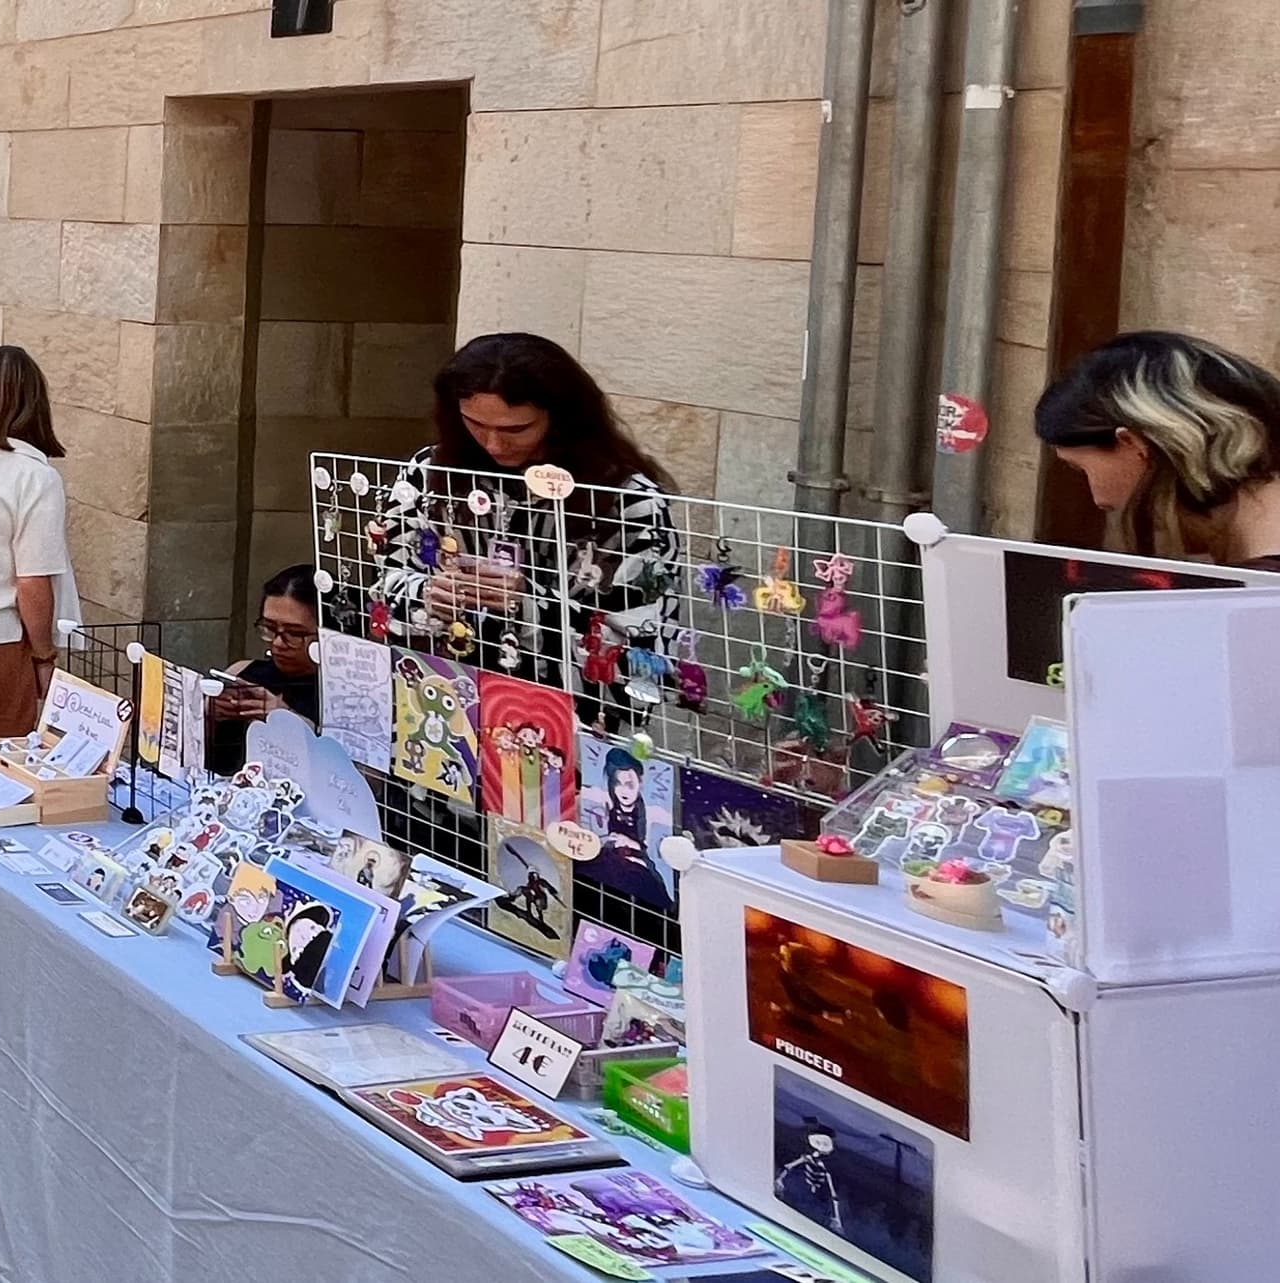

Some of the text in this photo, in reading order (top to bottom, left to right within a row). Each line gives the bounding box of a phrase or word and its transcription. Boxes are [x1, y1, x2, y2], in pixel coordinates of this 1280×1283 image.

[568, 840, 585, 856] 4€
[512, 1046, 554, 1077] 4€
[775, 1037, 843, 1079] PROCEED
